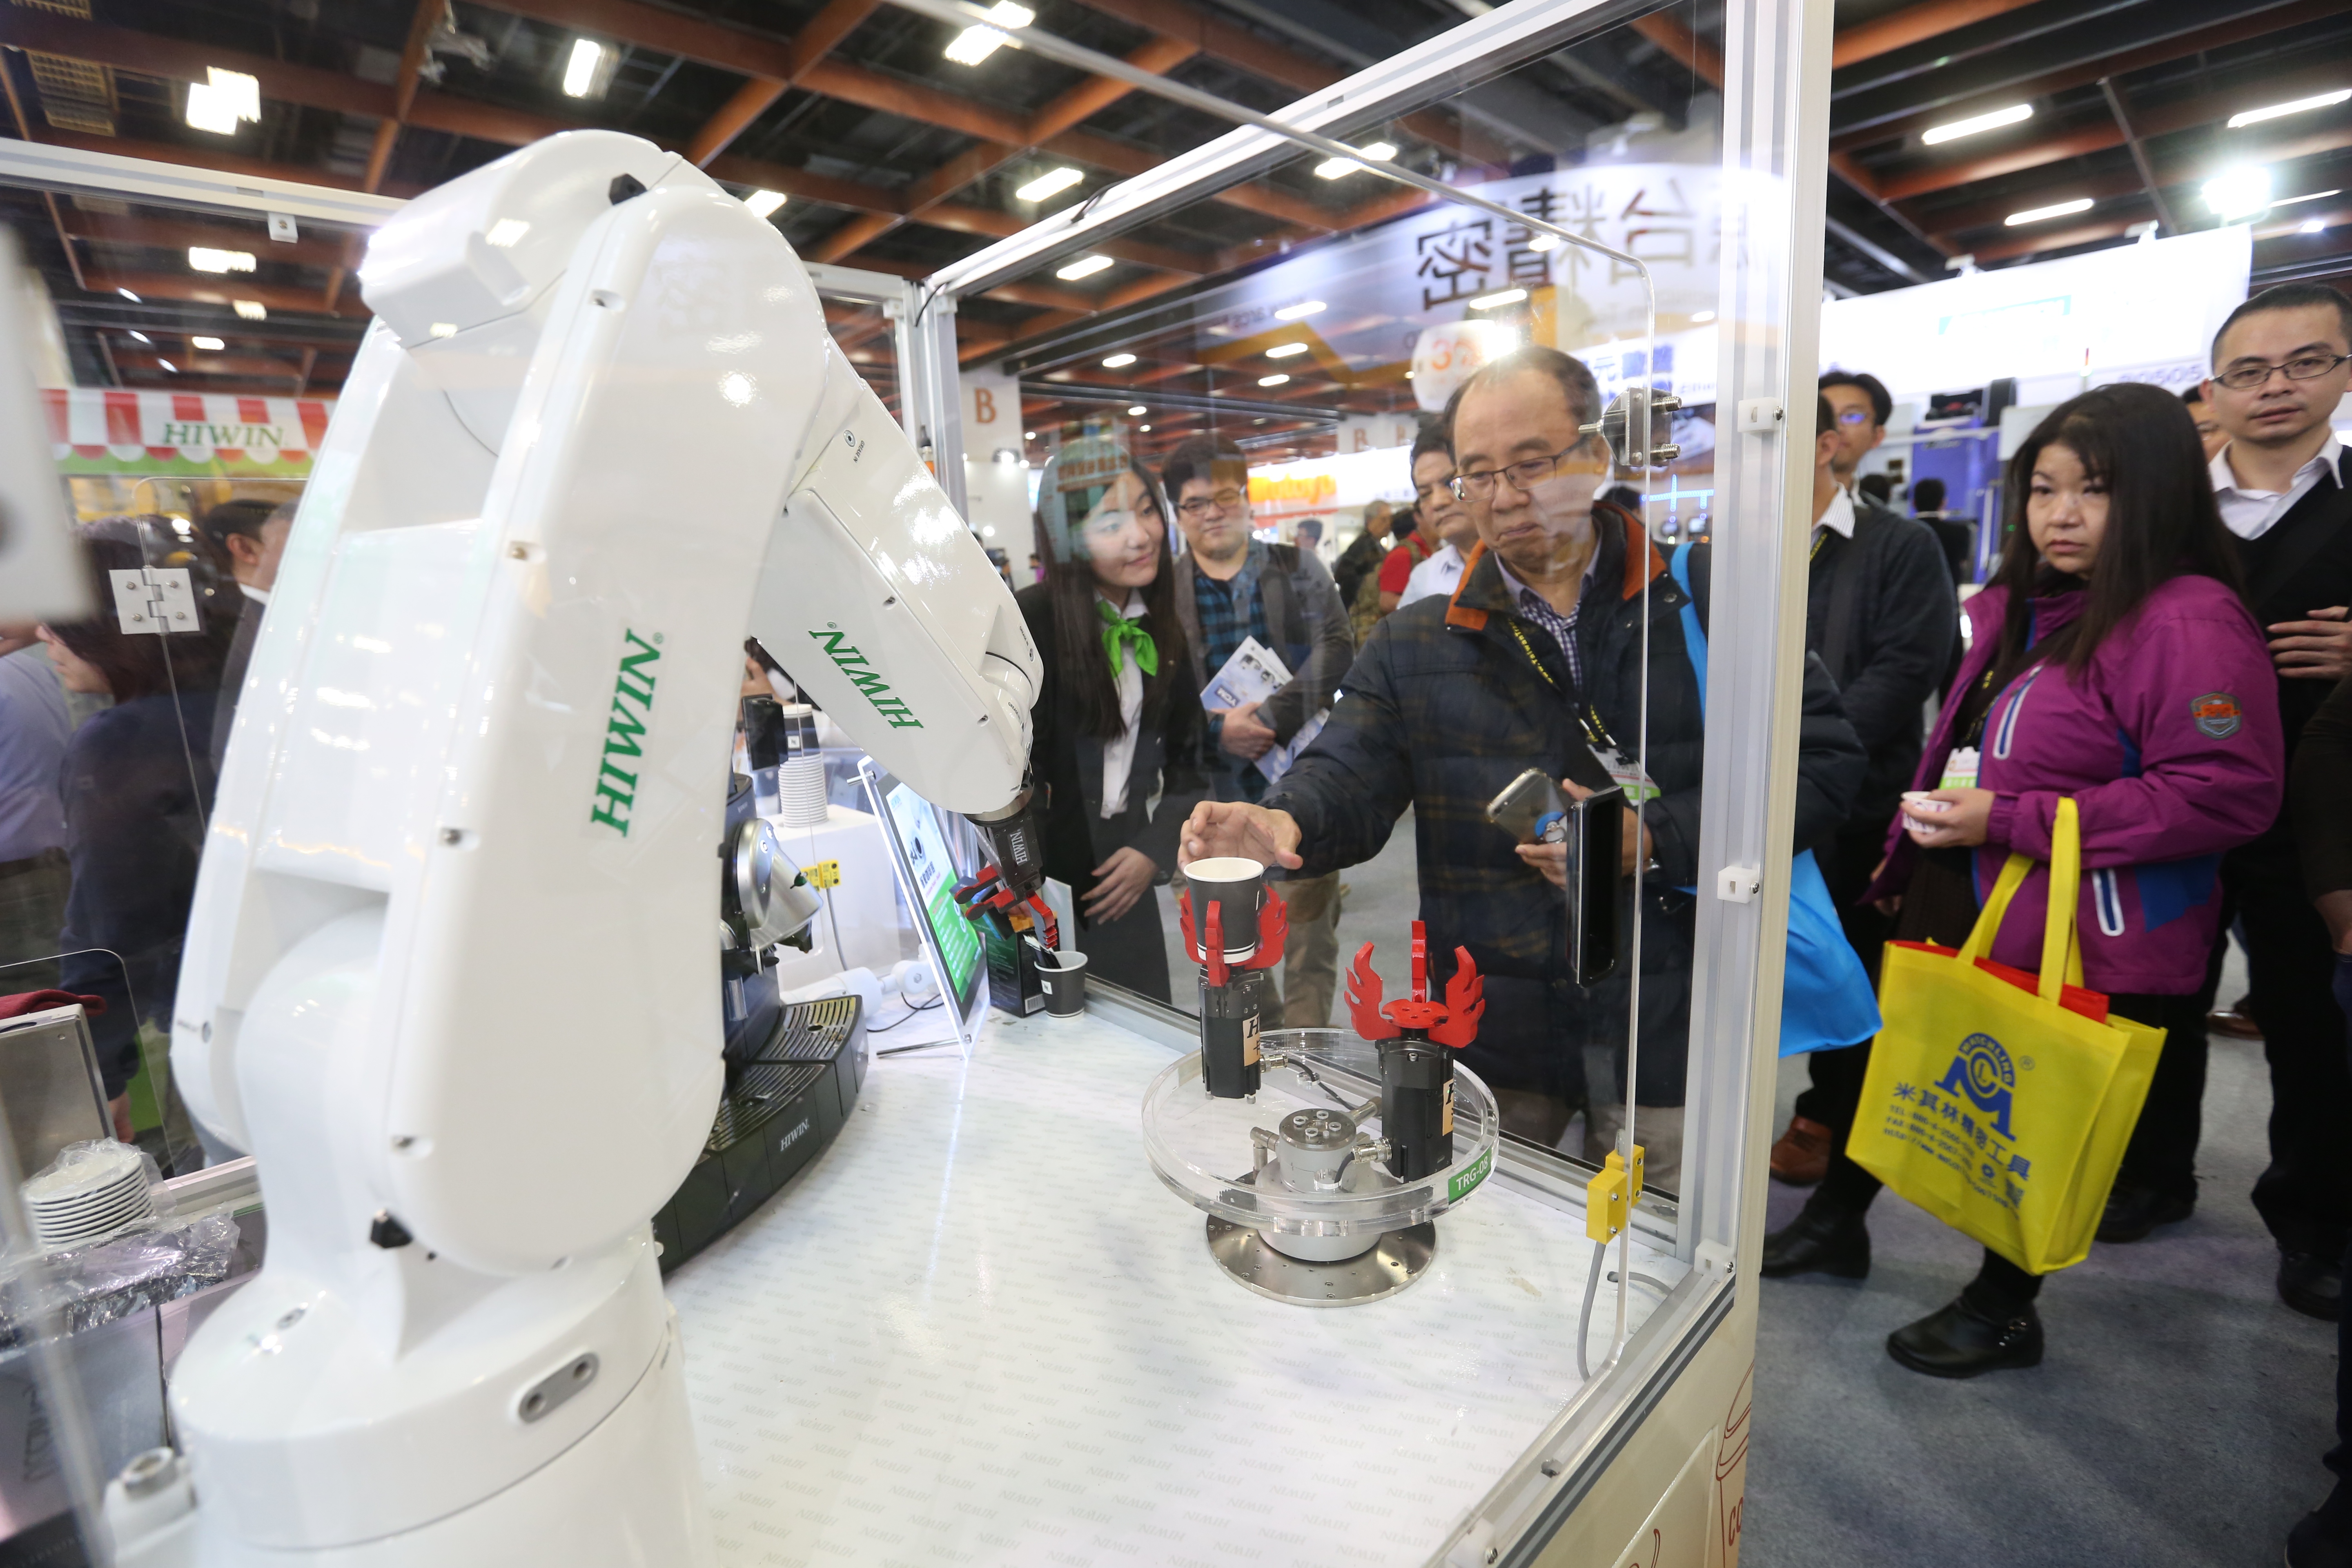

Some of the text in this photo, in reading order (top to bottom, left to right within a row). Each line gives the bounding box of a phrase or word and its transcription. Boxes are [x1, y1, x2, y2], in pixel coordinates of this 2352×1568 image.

[975, 388, 996, 423] B
[161, 423, 284, 447] HIWIN
[780, 1116, 810, 1153] HIWIN
[1456, 1156, 1488, 1191] TRG-08
